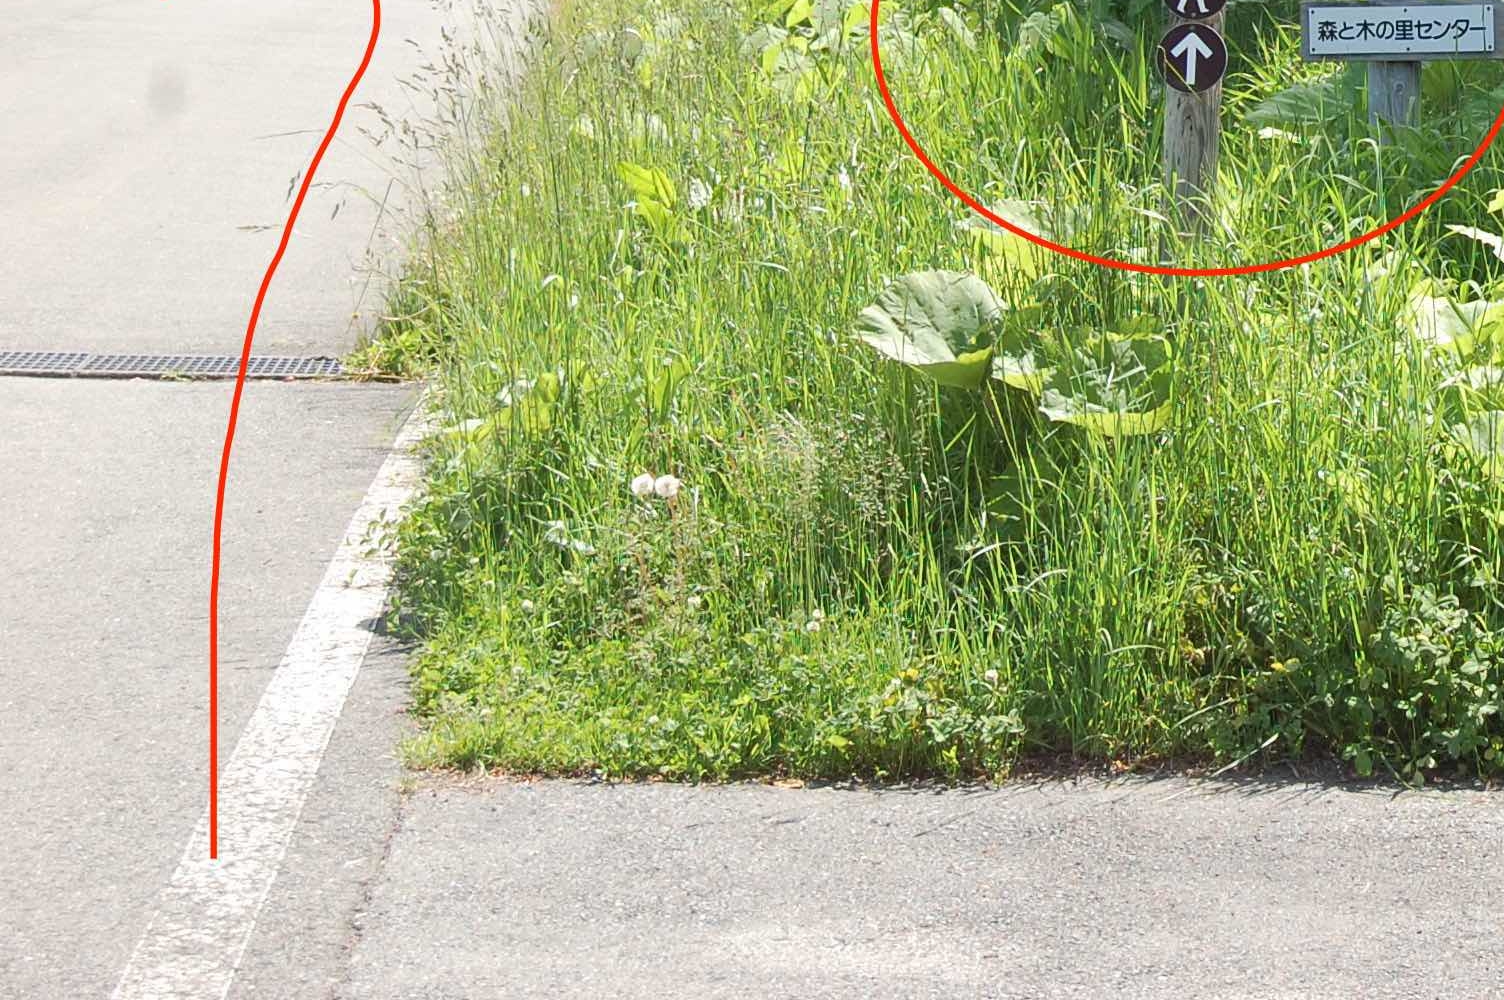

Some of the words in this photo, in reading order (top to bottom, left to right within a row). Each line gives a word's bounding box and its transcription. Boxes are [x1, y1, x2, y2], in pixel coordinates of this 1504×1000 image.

[1318, 19, 1486, 41] 森と木の里センター
